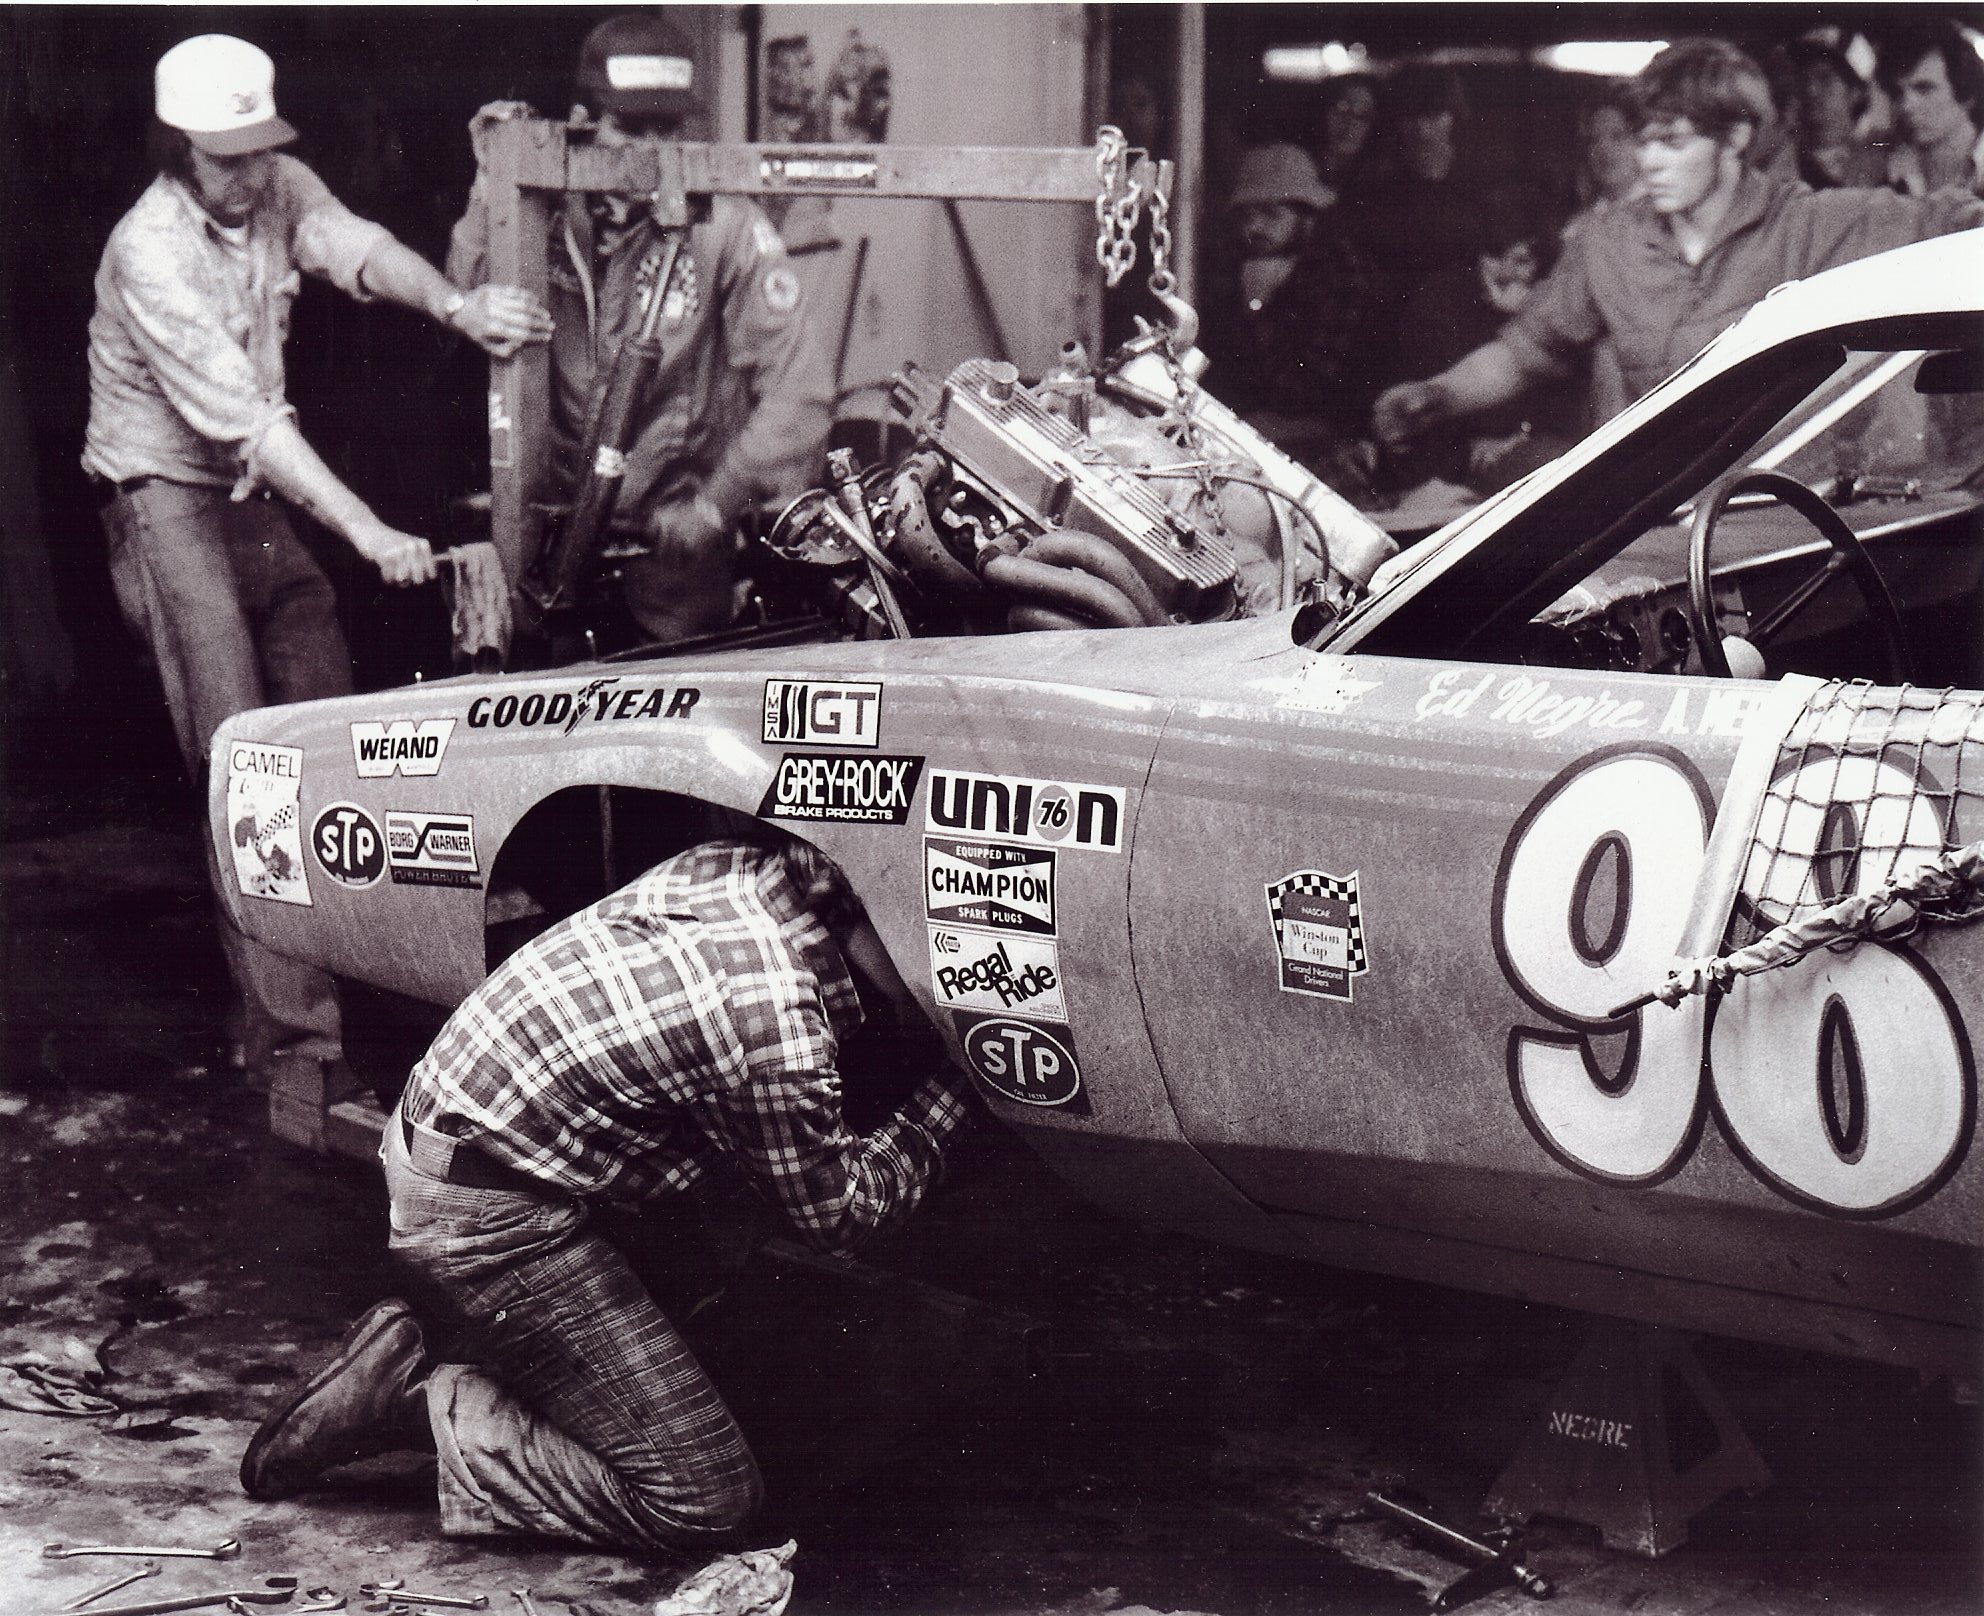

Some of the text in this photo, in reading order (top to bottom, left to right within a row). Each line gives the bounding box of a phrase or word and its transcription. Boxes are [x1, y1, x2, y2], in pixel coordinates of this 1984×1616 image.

[467, 687, 701, 729] GOODYEAR
[810, 690, 876, 735] GT
[1415, 669, 1650, 739] Ed Negre
[233, 749, 298, 778] CAMEL
[360, 736, 439, 760] WEIAND
[776, 758, 910, 808] GREY-ROCK
[774, 804, 894, 820] BRAKE PRODUCTS
[1038, 797, 1069, 828] 76
[321, 810, 375, 871] STP
[389, 832, 470, 852] BORG WARNER
[955, 845, 1027, 863] EQUIPPED WITH
[931, 866, 1048, 904] CHAMPION
[958, 906, 1023, 924] SPARK PLUGS
[1301, 906, 1331, 918] NASCAR
[1288, 962, 1312, 975] Grand
[1302, 942, 1328, 961] Cup
[937, 941, 1014, 1000] Regal
[994, 964, 1057, 1008] Ride
[981, 1028, 1060, 1086] STP
[1549, 1411, 1633, 1448] NEGRE
